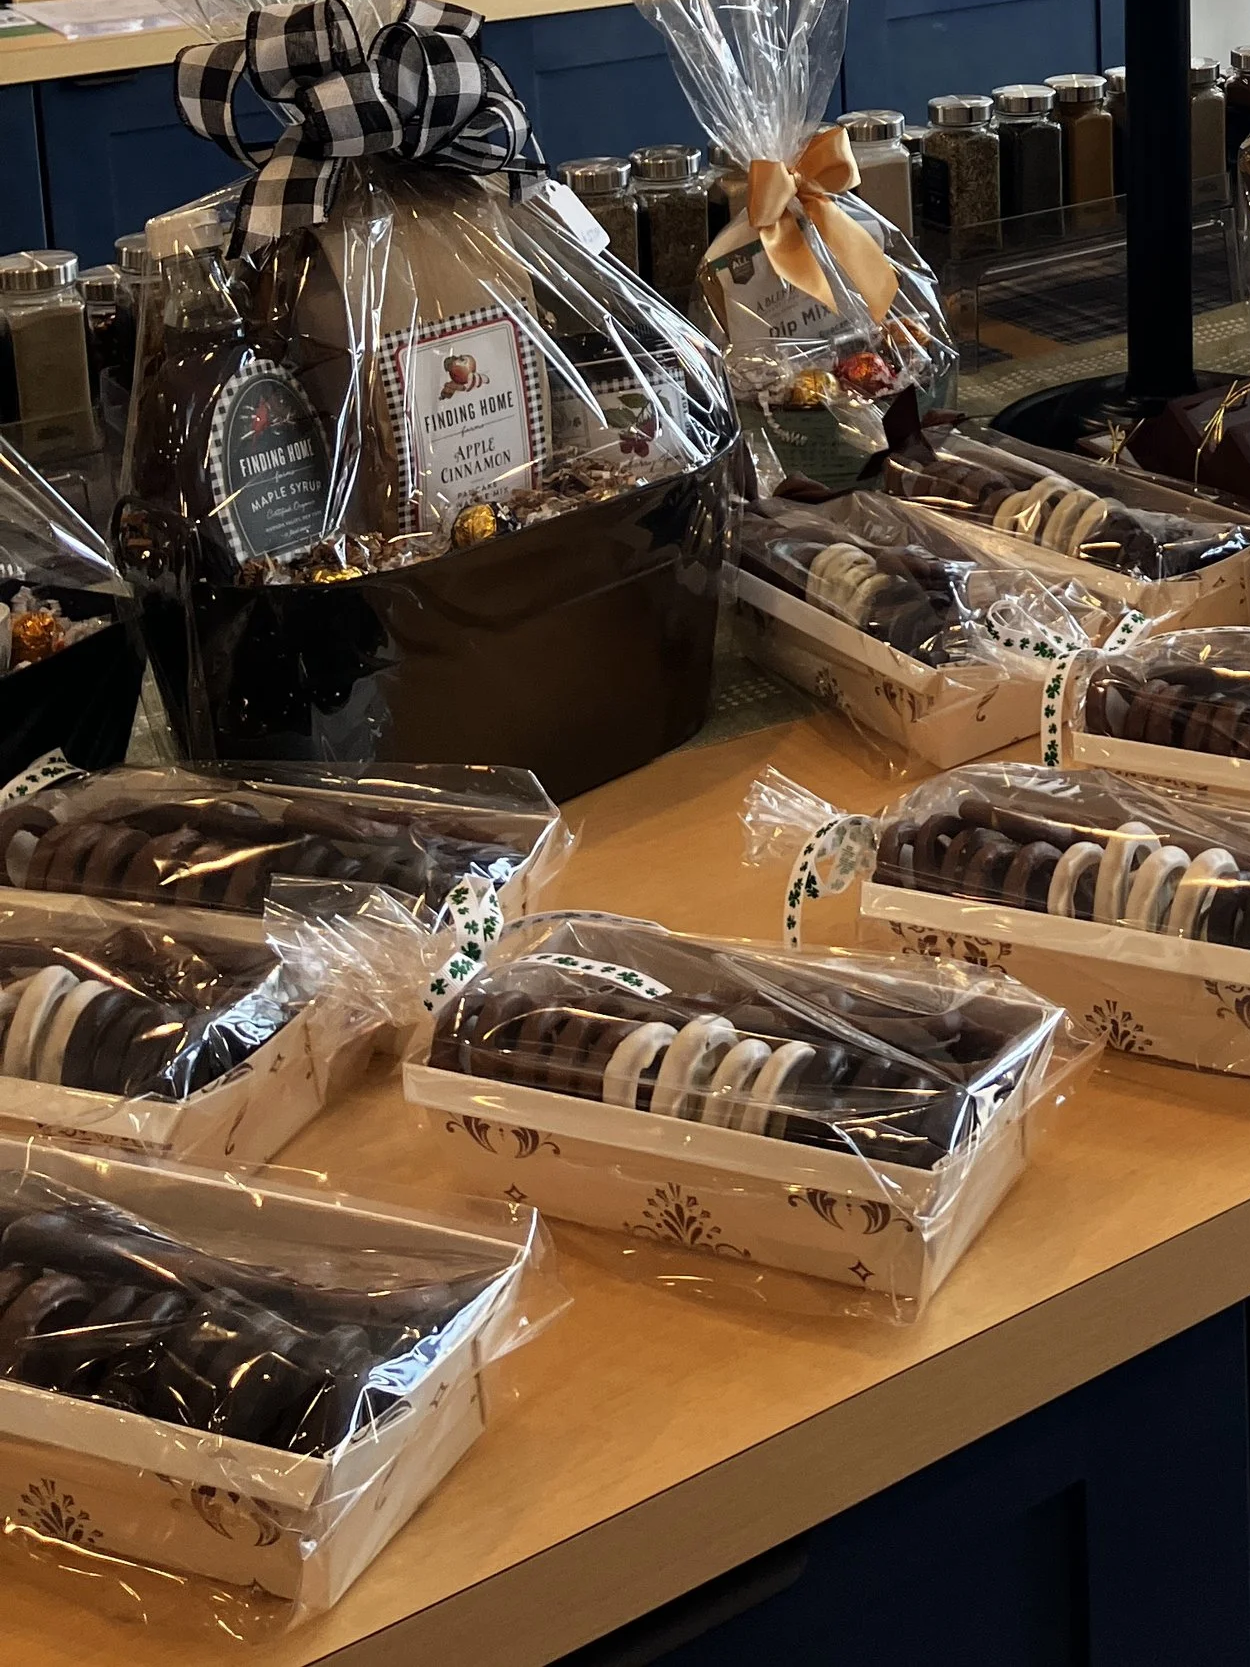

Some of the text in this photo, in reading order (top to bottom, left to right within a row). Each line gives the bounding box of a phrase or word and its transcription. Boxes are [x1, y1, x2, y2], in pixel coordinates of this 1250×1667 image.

[769, 304, 831, 339] Dip Mix
[424, 390, 514, 434] FINDING HOME
[239, 447, 286, 477] FINDING
[440, 449, 511, 485] CINNAMON
[453, 436, 495, 464] APPLE
[250, 480, 322, 513] MAPLE SYRUP
